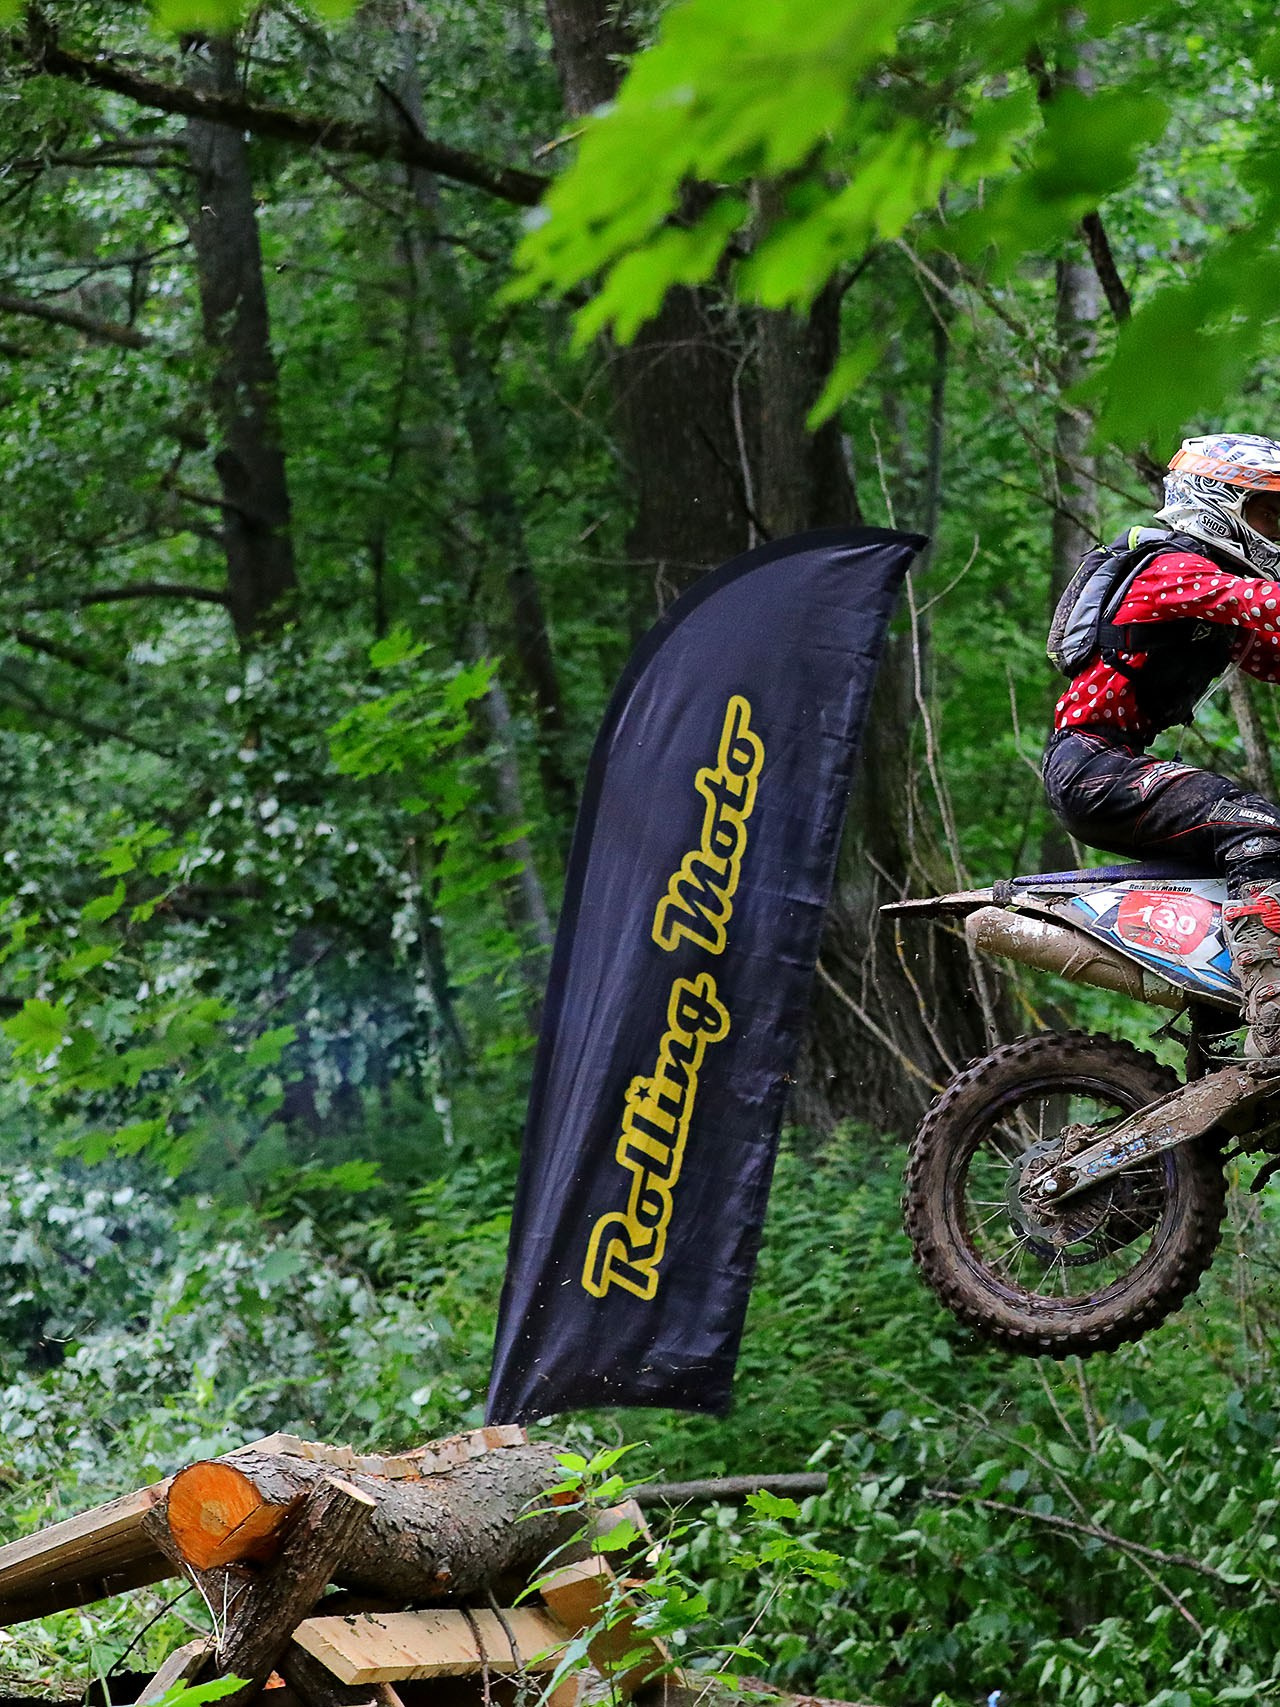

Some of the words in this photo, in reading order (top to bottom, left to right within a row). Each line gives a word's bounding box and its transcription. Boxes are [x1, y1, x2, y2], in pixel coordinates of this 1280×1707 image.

[1201, 515, 1227, 536] SHOEI
[652, 694, 766, 956] Moto
[1161, 885, 1192, 893] Maksim
[1137, 905, 1197, 936] 130
[582, 972, 731, 1302] Rolling
